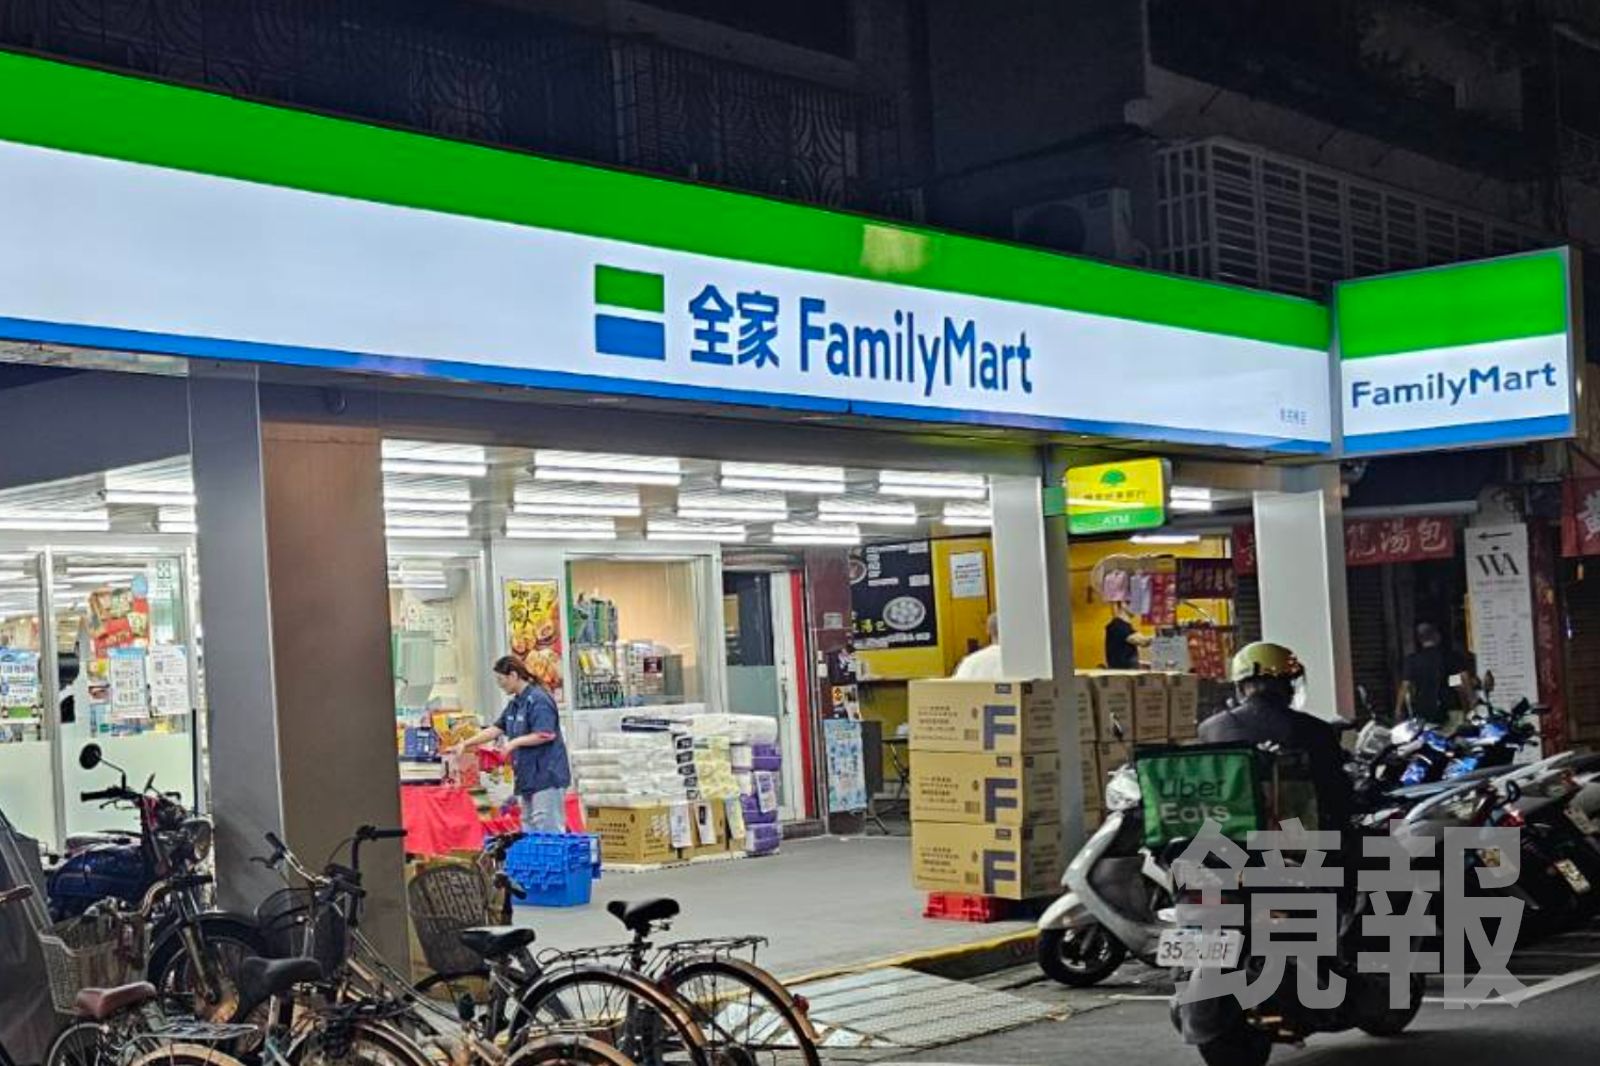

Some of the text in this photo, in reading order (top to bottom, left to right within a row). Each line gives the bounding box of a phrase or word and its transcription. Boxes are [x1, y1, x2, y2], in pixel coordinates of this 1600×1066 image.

[688, 284, 1033, 396] 全家 FamilyMart
[1352, 363, 1557, 408] FamilyMart
[983, 705, 1016, 751] F
[984, 778, 1018, 824] F
[1161, 778, 1224, 798] Uber
[1161, 802, 1231, 825] Eats
[983, 849, 1017, 895] F
